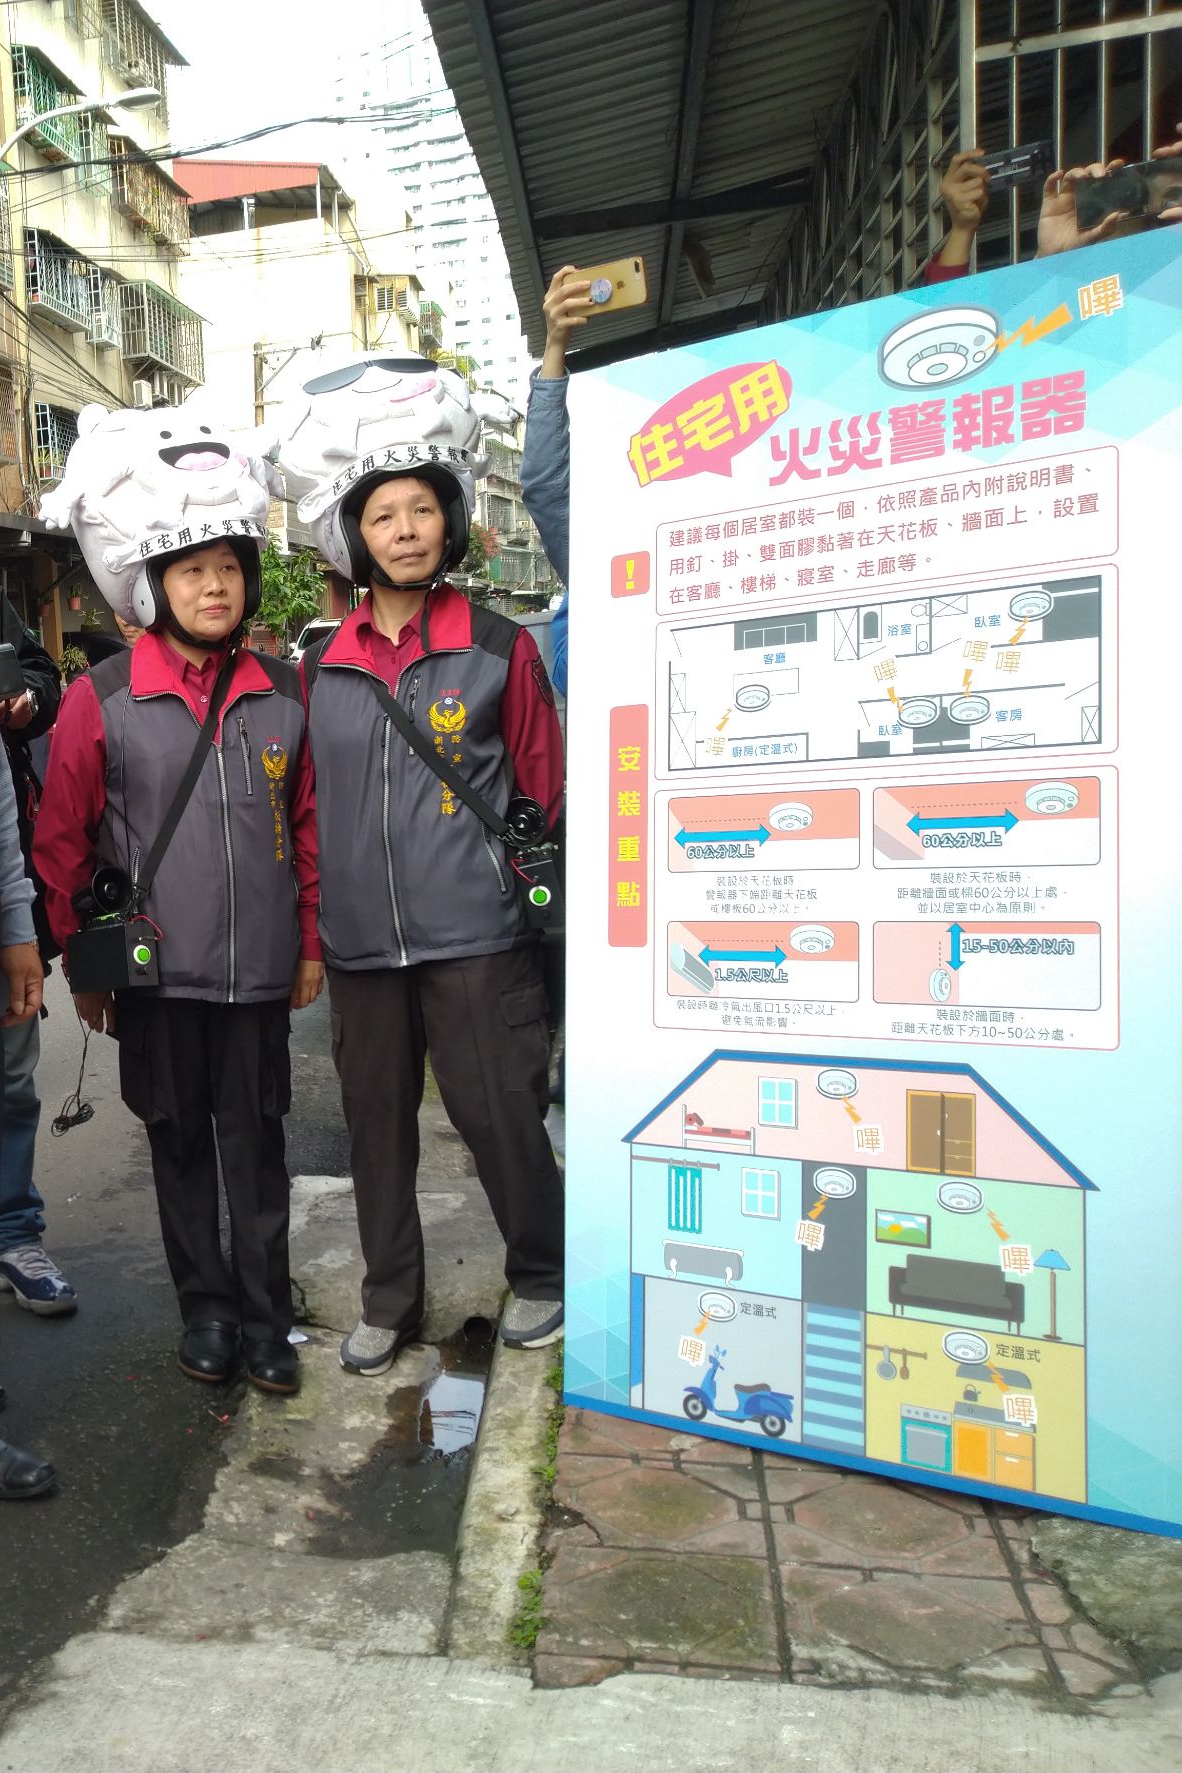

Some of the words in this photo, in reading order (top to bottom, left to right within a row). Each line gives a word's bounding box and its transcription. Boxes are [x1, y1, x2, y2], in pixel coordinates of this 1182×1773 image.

[1079, 275, 1124, 321] 嗶
[630, 361, 791, 486] 住宅用
[769, 370, 1088, 486] 火災警報器
[887, 622, 913, 638] 浴室
[974, 614, 1002, 629] 臥室
[763, 652, 786, 666] 客廳
[996, 708, 1023, 723] 客房
[878, 724, 903, 737] 臥室
[617, 745, 642, 908] 安裝重點
[921, 831, 1003, 849] 60公分以上
[686, 843, 755, 860] 60公分以上
[962, 938, 1075, 955] 15-50公分以內
[715, 967, 788, 984] 1.5公尺以上
[856, 1127, 882, 1152] 嗶
[797, 1223, 823, 1248] 嗶
[1002, 1247, 1032, 1273] 嗶
[740, 1301, 777, 1319] 定溫式
[681, 1338, 704, 1364] 嗶
[996, 1343, 1041, 1363] 定溫式
[1006, 1397, 1036, 1424] 嗶
